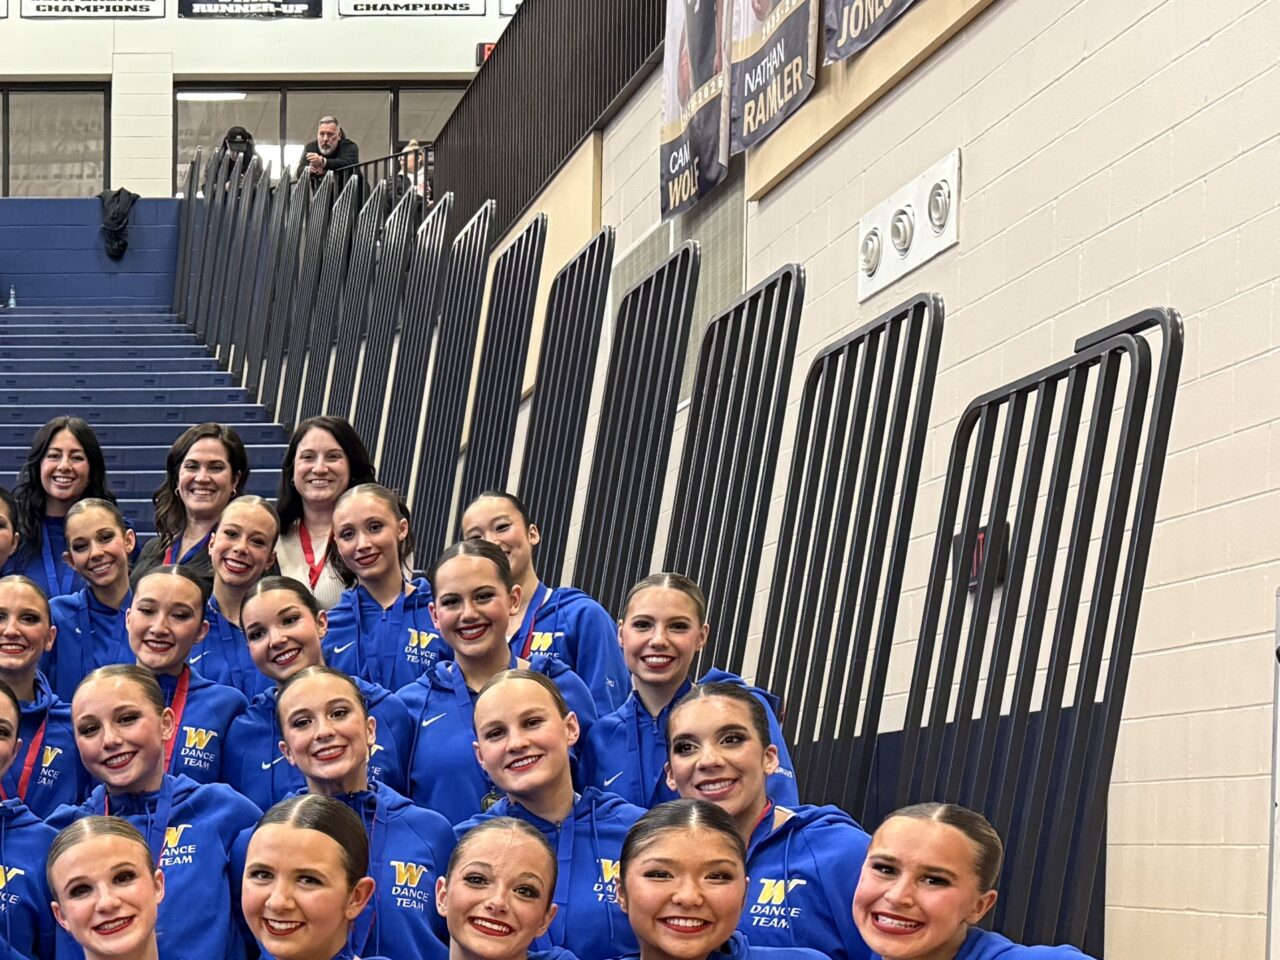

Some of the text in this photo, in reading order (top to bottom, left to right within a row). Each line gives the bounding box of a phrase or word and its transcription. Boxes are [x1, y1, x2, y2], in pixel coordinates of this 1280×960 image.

[35, 4, 150, 12] CHAMPIONS
[192, 3, 308, 14] RUNNER-UP
[353, 3, 470, 11] CHAMPIONS
[744, 38, 785, 97] NATHAN
[743, 55, 803, 137] RAMLER
[668, 156, 700, 210] WOLF
[183, 726, 218, 750] W
[181, 747, 216, 762] DANCE
[184, 757, 210, 770] TEAM
[40, 768, 61, 779] NCE
[161, 844, 197, 856] ANCE
[159, 855, 193, 867] TEAM
[390, 861, 428, 888] W
[391, 886, 430, 903] DANCE
[757, 877, 808, 905] W
[396, 897, 424, 912] TEAM
[749, 904, 802, 918] DANCE
[751, 917, 790, 929] TEAM
